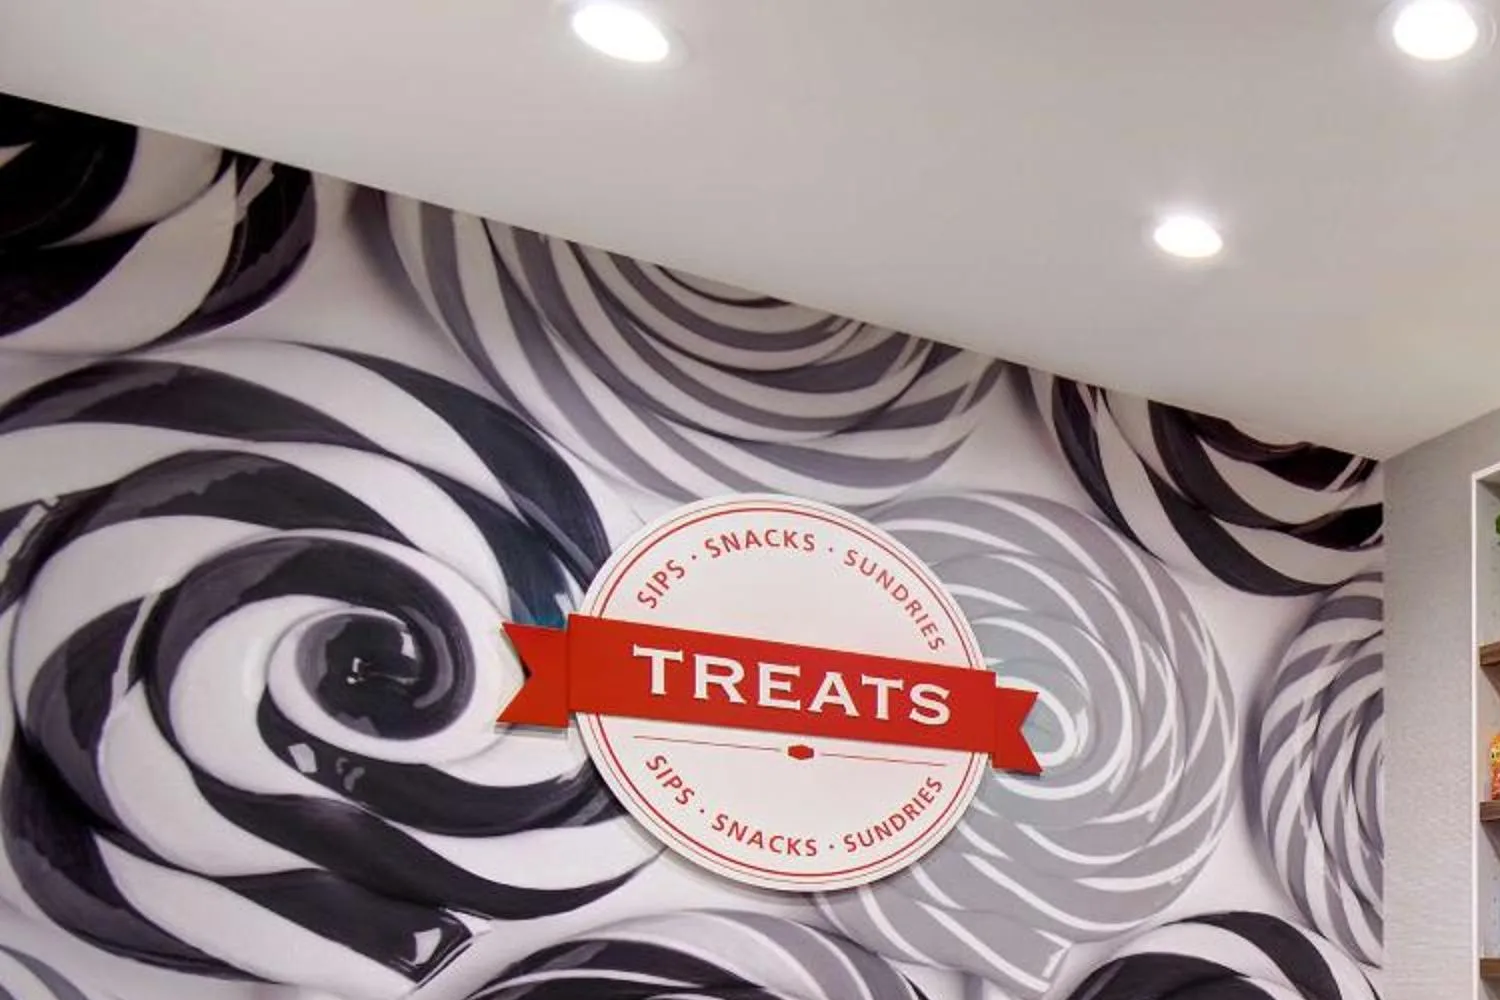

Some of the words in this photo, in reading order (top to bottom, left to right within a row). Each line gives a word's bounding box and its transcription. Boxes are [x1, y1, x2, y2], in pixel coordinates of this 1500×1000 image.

[637, 558, 687, 609] SIPS
[704, 528, 816, 558] SNACKS
[843, 548, 945, 652] SUNDRIES
[632, 643, 952, 727] TREATS
[646, 754, 696, 806] SIPS
[711, 814, 818, 857] SNACKS
[843, 776, 943, 853] SUNDRIES
